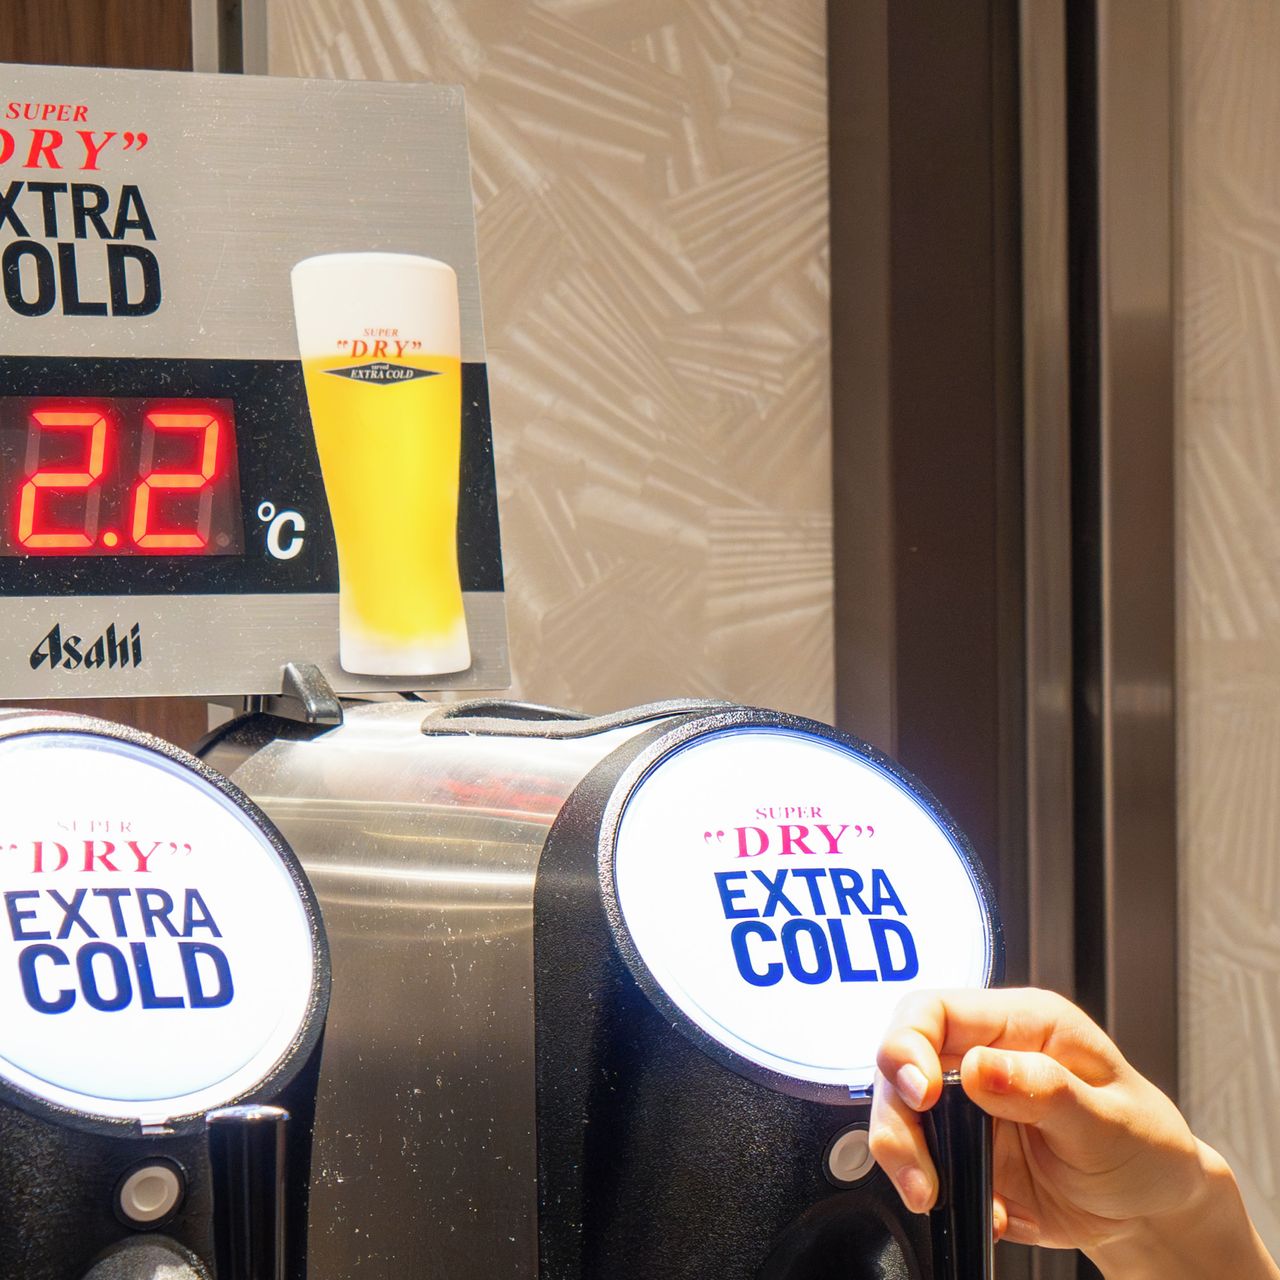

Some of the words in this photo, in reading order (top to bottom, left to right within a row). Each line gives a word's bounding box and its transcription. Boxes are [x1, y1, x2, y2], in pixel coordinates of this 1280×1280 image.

[6, 102, 88, 122] SUPER
[0, 128, 148, 171] RY”
[0, 181, 157, 241] XTRA
[2, 240, 162, 317] OLD
[363, 327, 399, 337] SUPER
[350, 369, 384, 379] EXTRA
[385, 369, 414, 379] COLD
[18, 410, 220, 549] 2.2
[29, 622, 142, 671] Asahi
[755, 806, 823, 820] SUPER
[3, 887, 223, 941] EXTRA
[713, 868, 908, 919] EXTRA
[18, 941, 234, 1015] COLD
[730, 918, 919, 987] COLD
